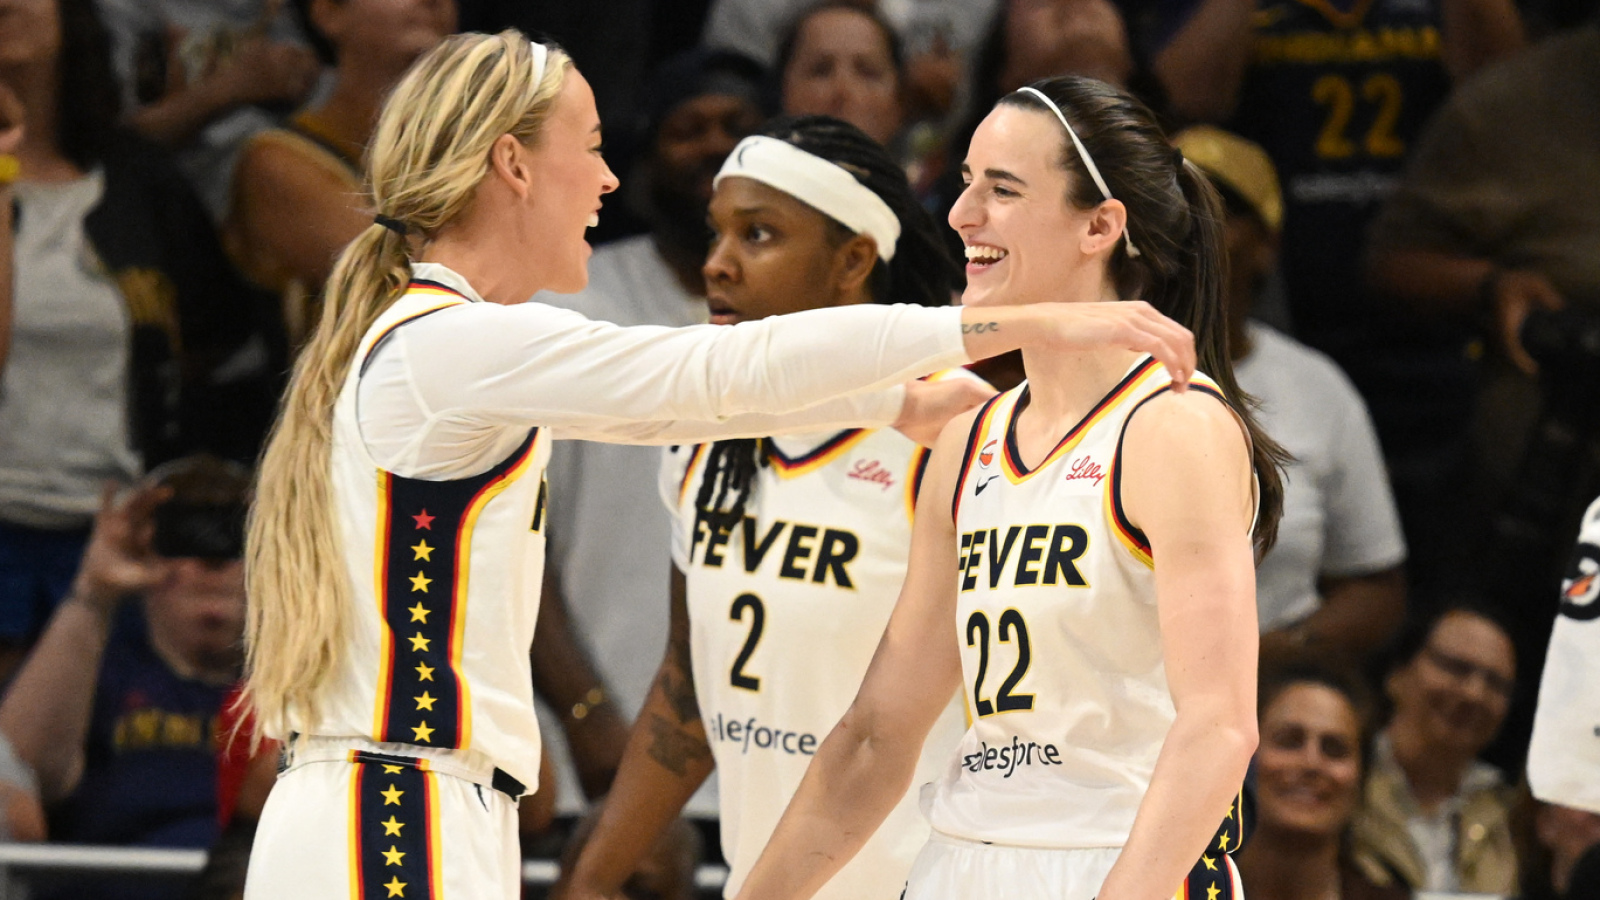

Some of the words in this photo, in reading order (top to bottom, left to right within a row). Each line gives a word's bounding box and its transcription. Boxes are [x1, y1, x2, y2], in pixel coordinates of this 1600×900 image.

[1312, 74, 1403, 158] 22
[847, 458, 896, 492] Lilly
[1065, 455, 1108, 487] Lilly
[728, 591, 766, 692] 2
[966, 606, 1037, 719] 22
